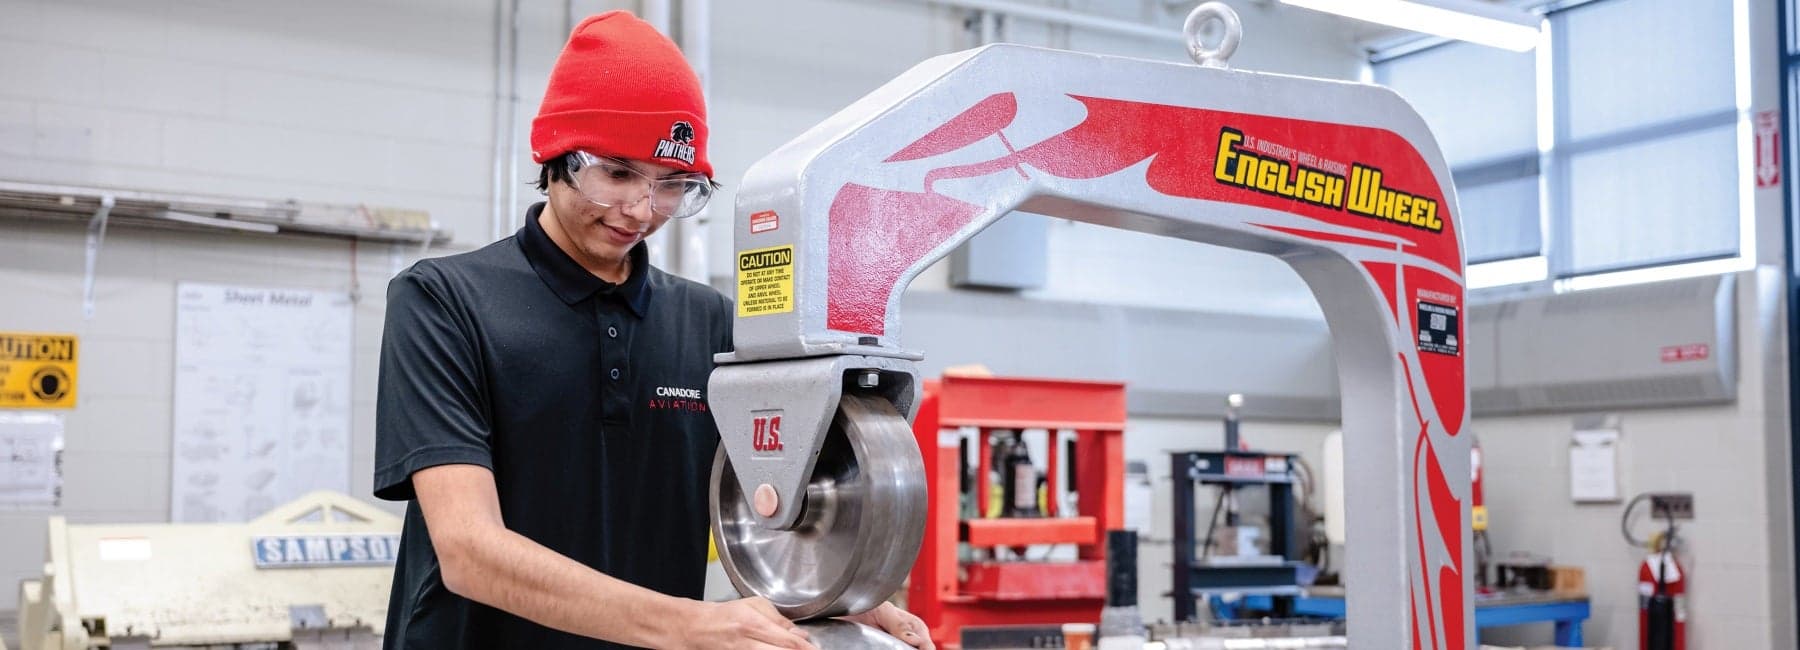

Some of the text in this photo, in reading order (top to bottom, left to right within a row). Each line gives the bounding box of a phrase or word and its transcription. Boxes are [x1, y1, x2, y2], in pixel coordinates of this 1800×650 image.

[654, 139, 696, 165] PANTHERS
[1243, 135, 1255, 149] U.S.
[1256, 138, 1297, 162] INDUSTRIAL'S
[1297, 151, 1317, 168] WHEEL
[1347, 166, 1442, 230] WHEEL
[740, 250, 790, 269] CAUTION
[648, 399, 706, 412] AVIATION
[656, 386, 701, 399] CANADORE
[753, 416, 783, 451] U.S.
